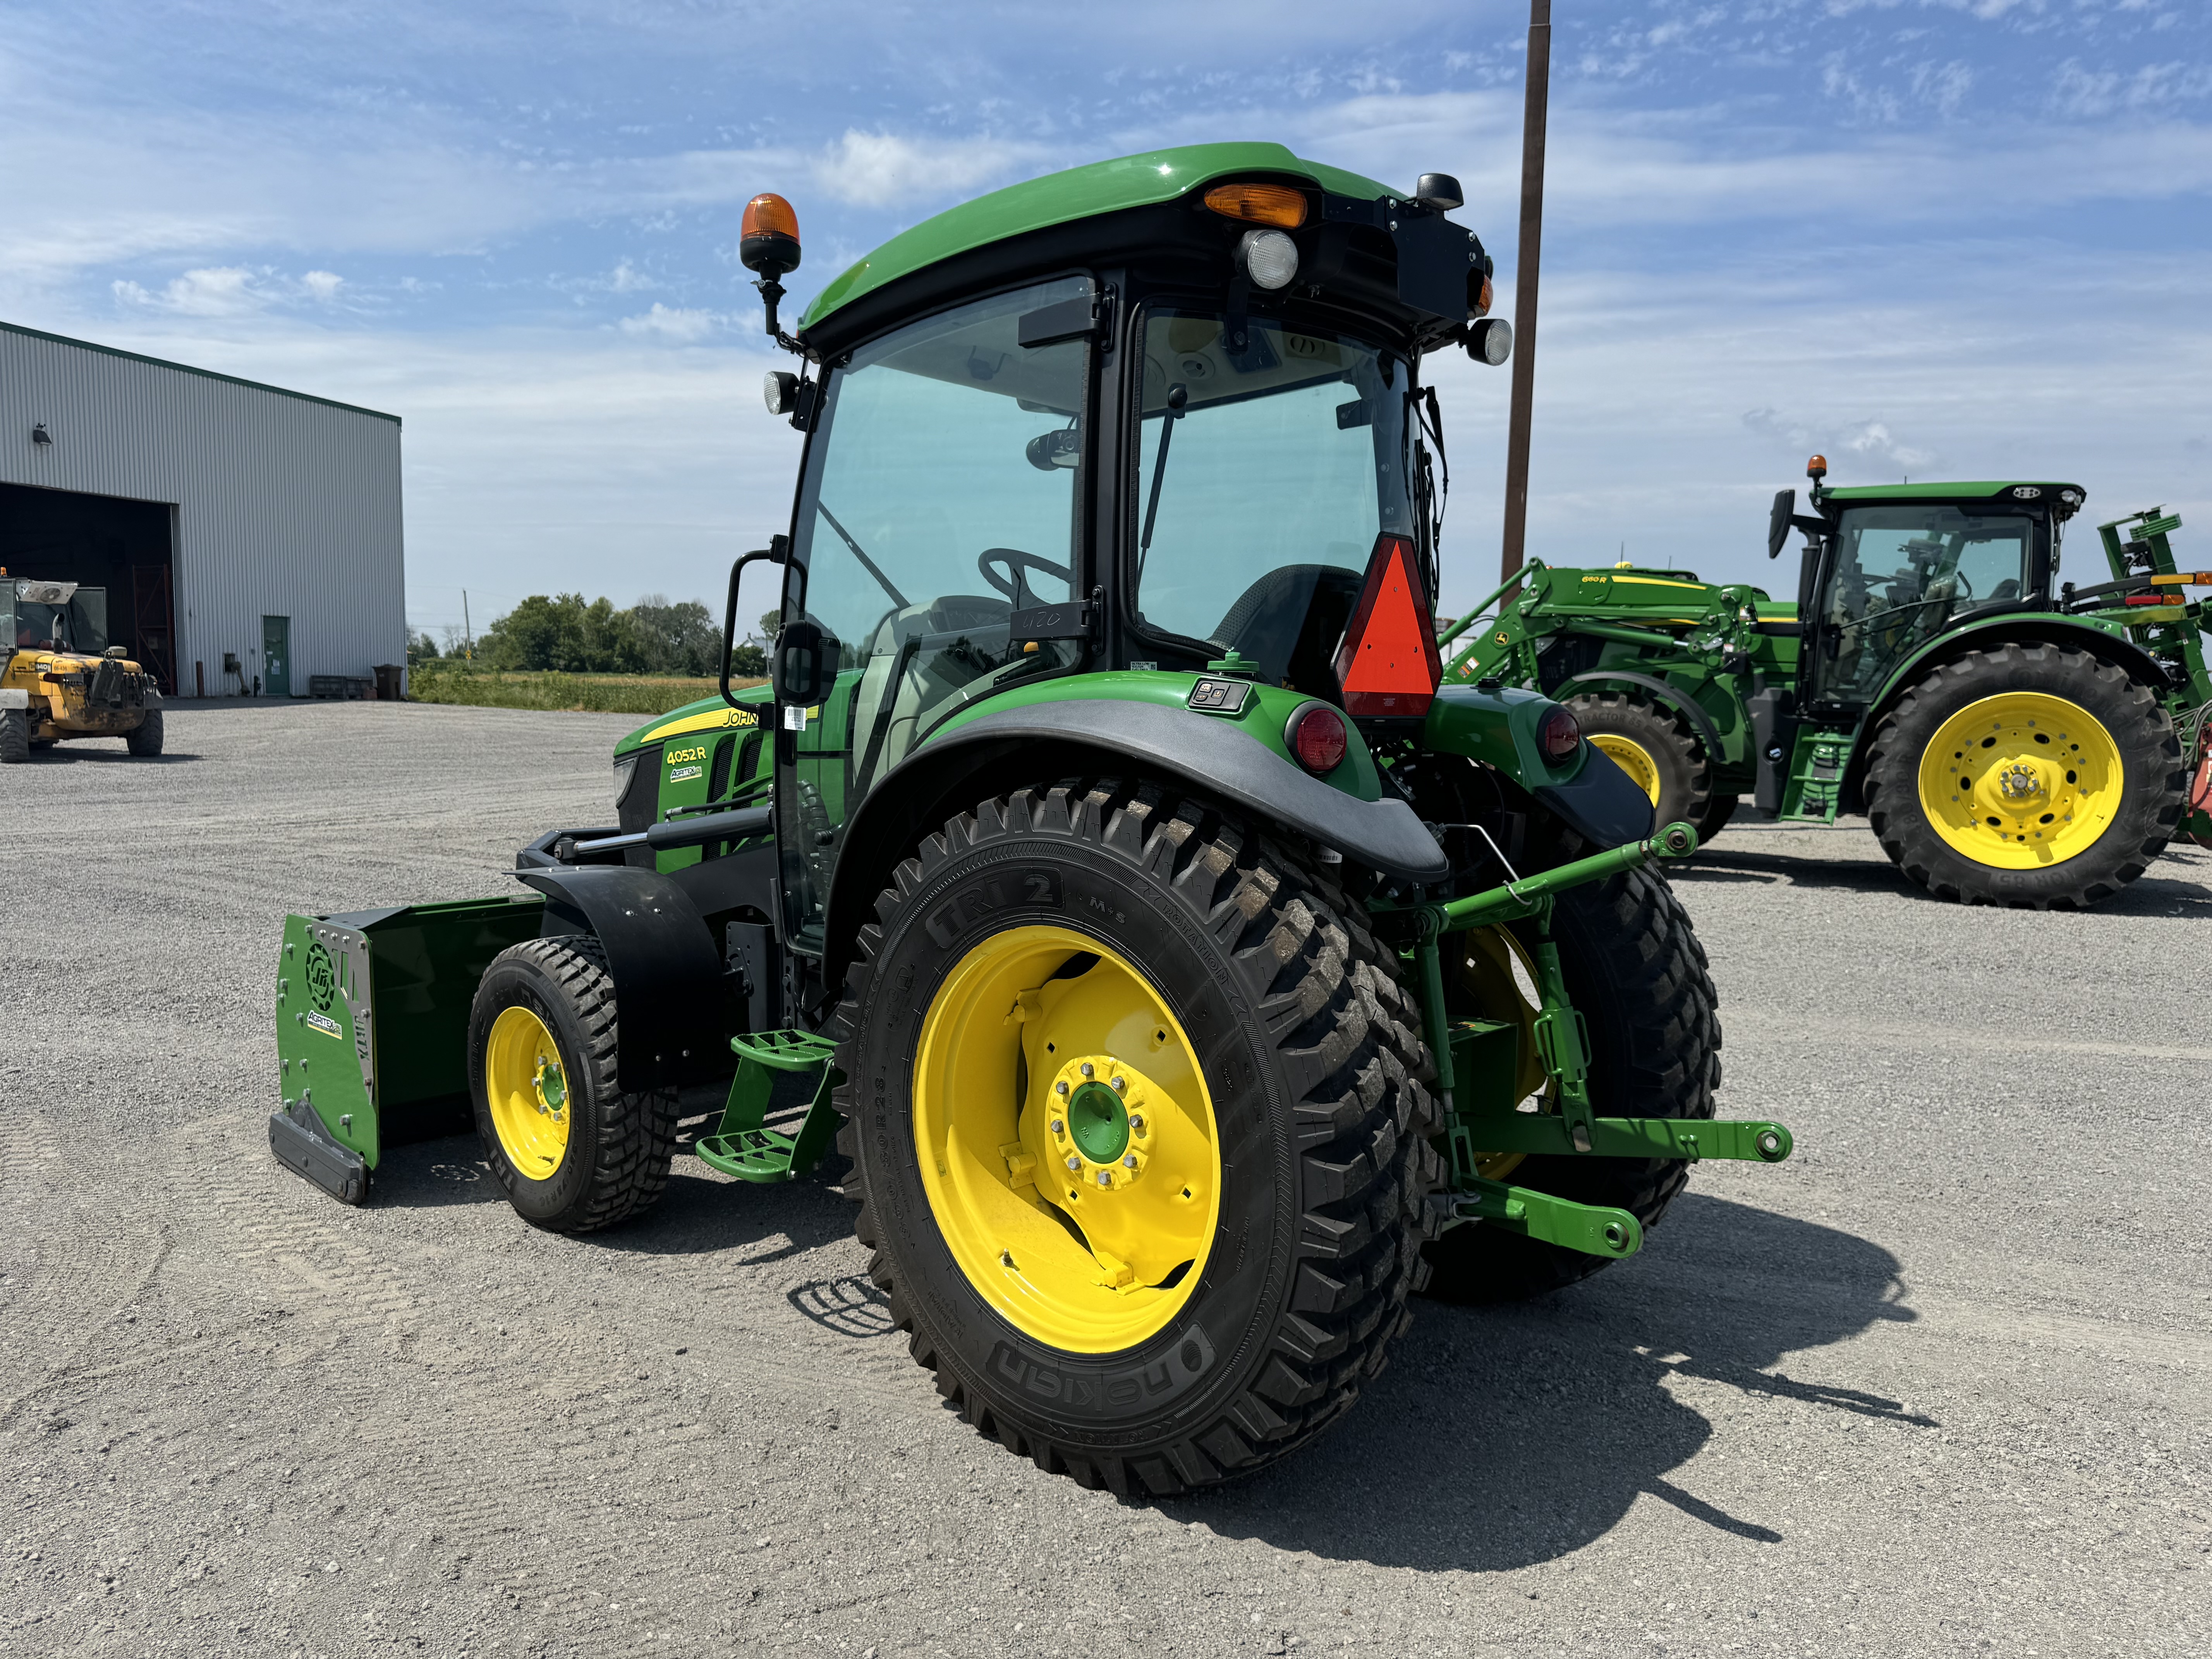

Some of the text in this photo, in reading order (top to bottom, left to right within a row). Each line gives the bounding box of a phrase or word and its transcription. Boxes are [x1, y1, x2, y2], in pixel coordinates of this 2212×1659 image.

[1023, 611, 1060, 631] 420
[667, 747, 707, 766] 4052R
[671, 767, 696, 778] AGRITEX
[933, 874, 1054, 937] TRI 2
[1089, 896, 1126, 925] M+S
[1163, 904, 1228, 985] ROTATION
[309, 1012, 335, 1029] AGRITEX
[856, 1000, 872, 1083] ROTATION
[1075, 1428, 1149, 1444] ROTATION
